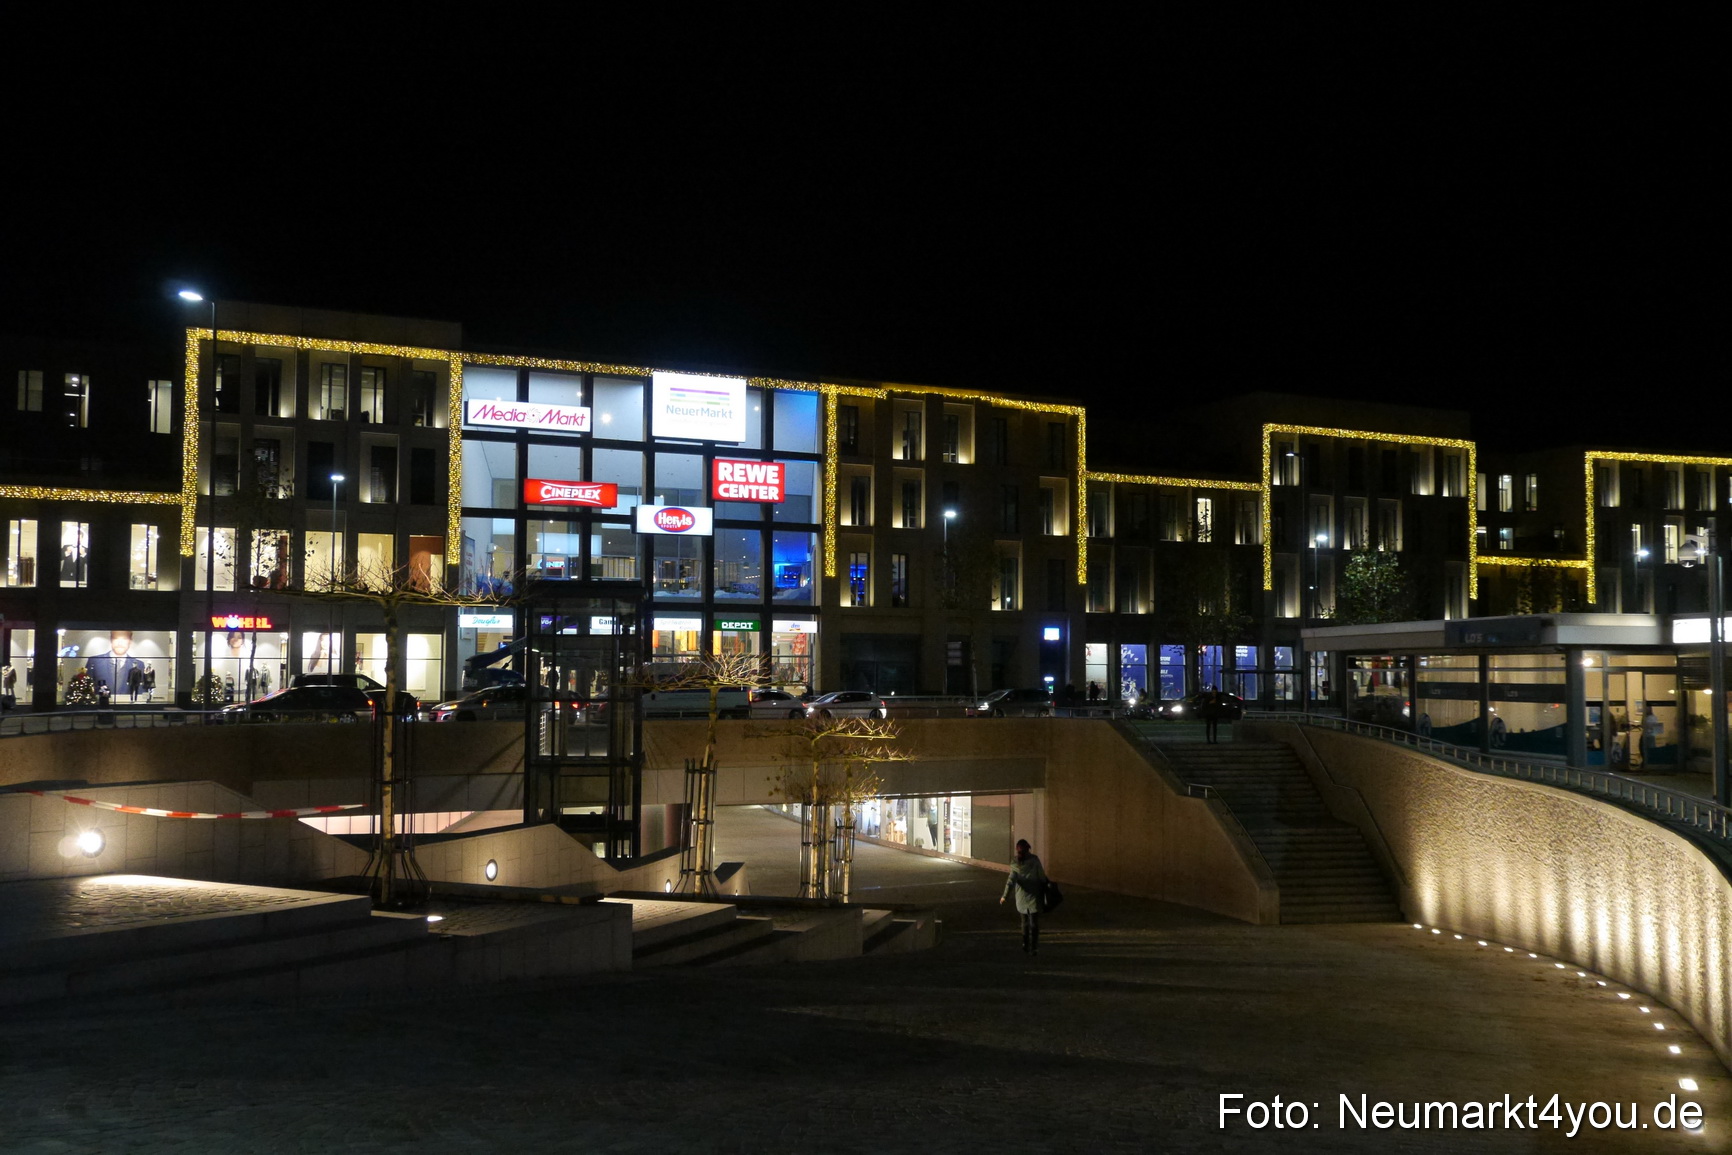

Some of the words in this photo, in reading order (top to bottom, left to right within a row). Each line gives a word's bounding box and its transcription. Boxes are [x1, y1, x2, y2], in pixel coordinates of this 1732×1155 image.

[472, 404, 527, 423] Media
[539, 408, 586, 427] Markt
[666, 404, 733, 419] NeuerMarkt
[718, 462, 779, 484] REWE
[540, 485, 601, 500] CINEPLEX
[718, 483, 779, 500] CENTER
[211, 615, 272, 628] WÖHRL
[721, 621, 754, 630] DEPOT
